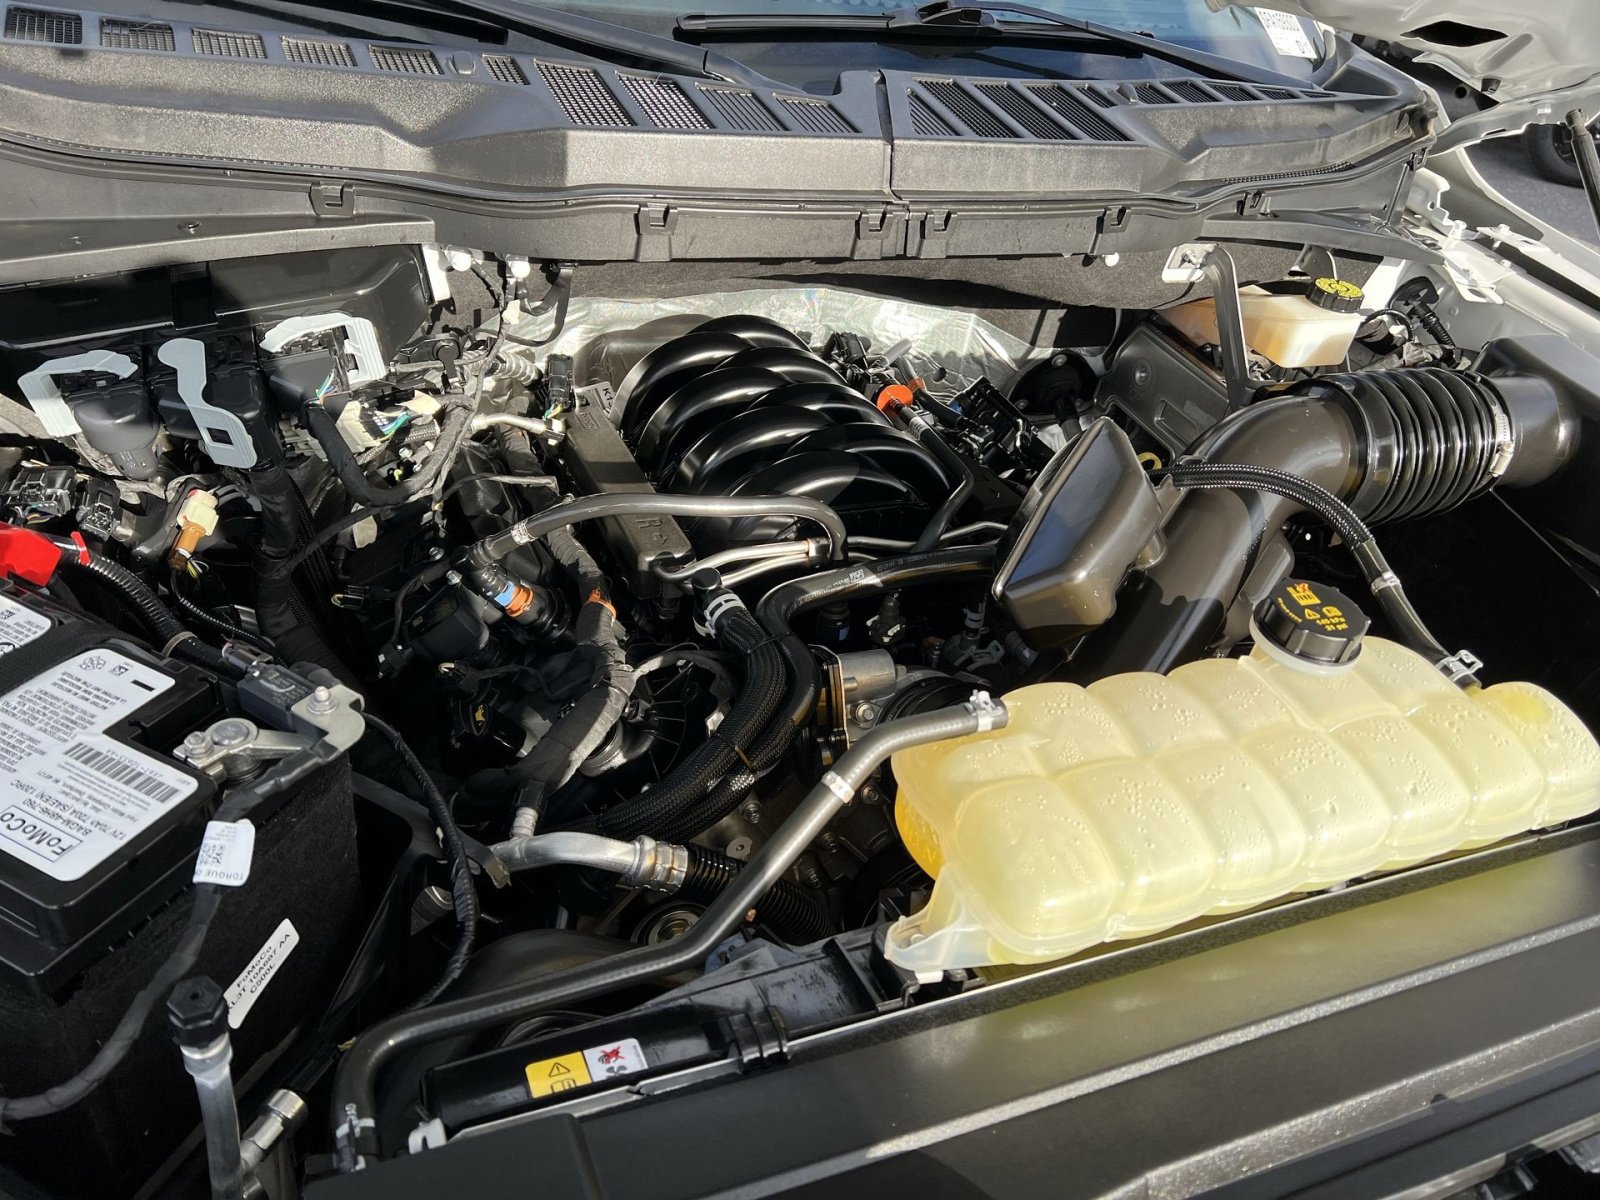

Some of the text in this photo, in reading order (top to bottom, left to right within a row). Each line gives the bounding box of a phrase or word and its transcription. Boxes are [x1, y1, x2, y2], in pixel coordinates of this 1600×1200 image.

[0, 810, 74, 857] FoMoCo
[206, 870, 244, 881] TORQUE
[279, 933, 291, 949] AA
[236, 946, 272, 989] FoMoCo
